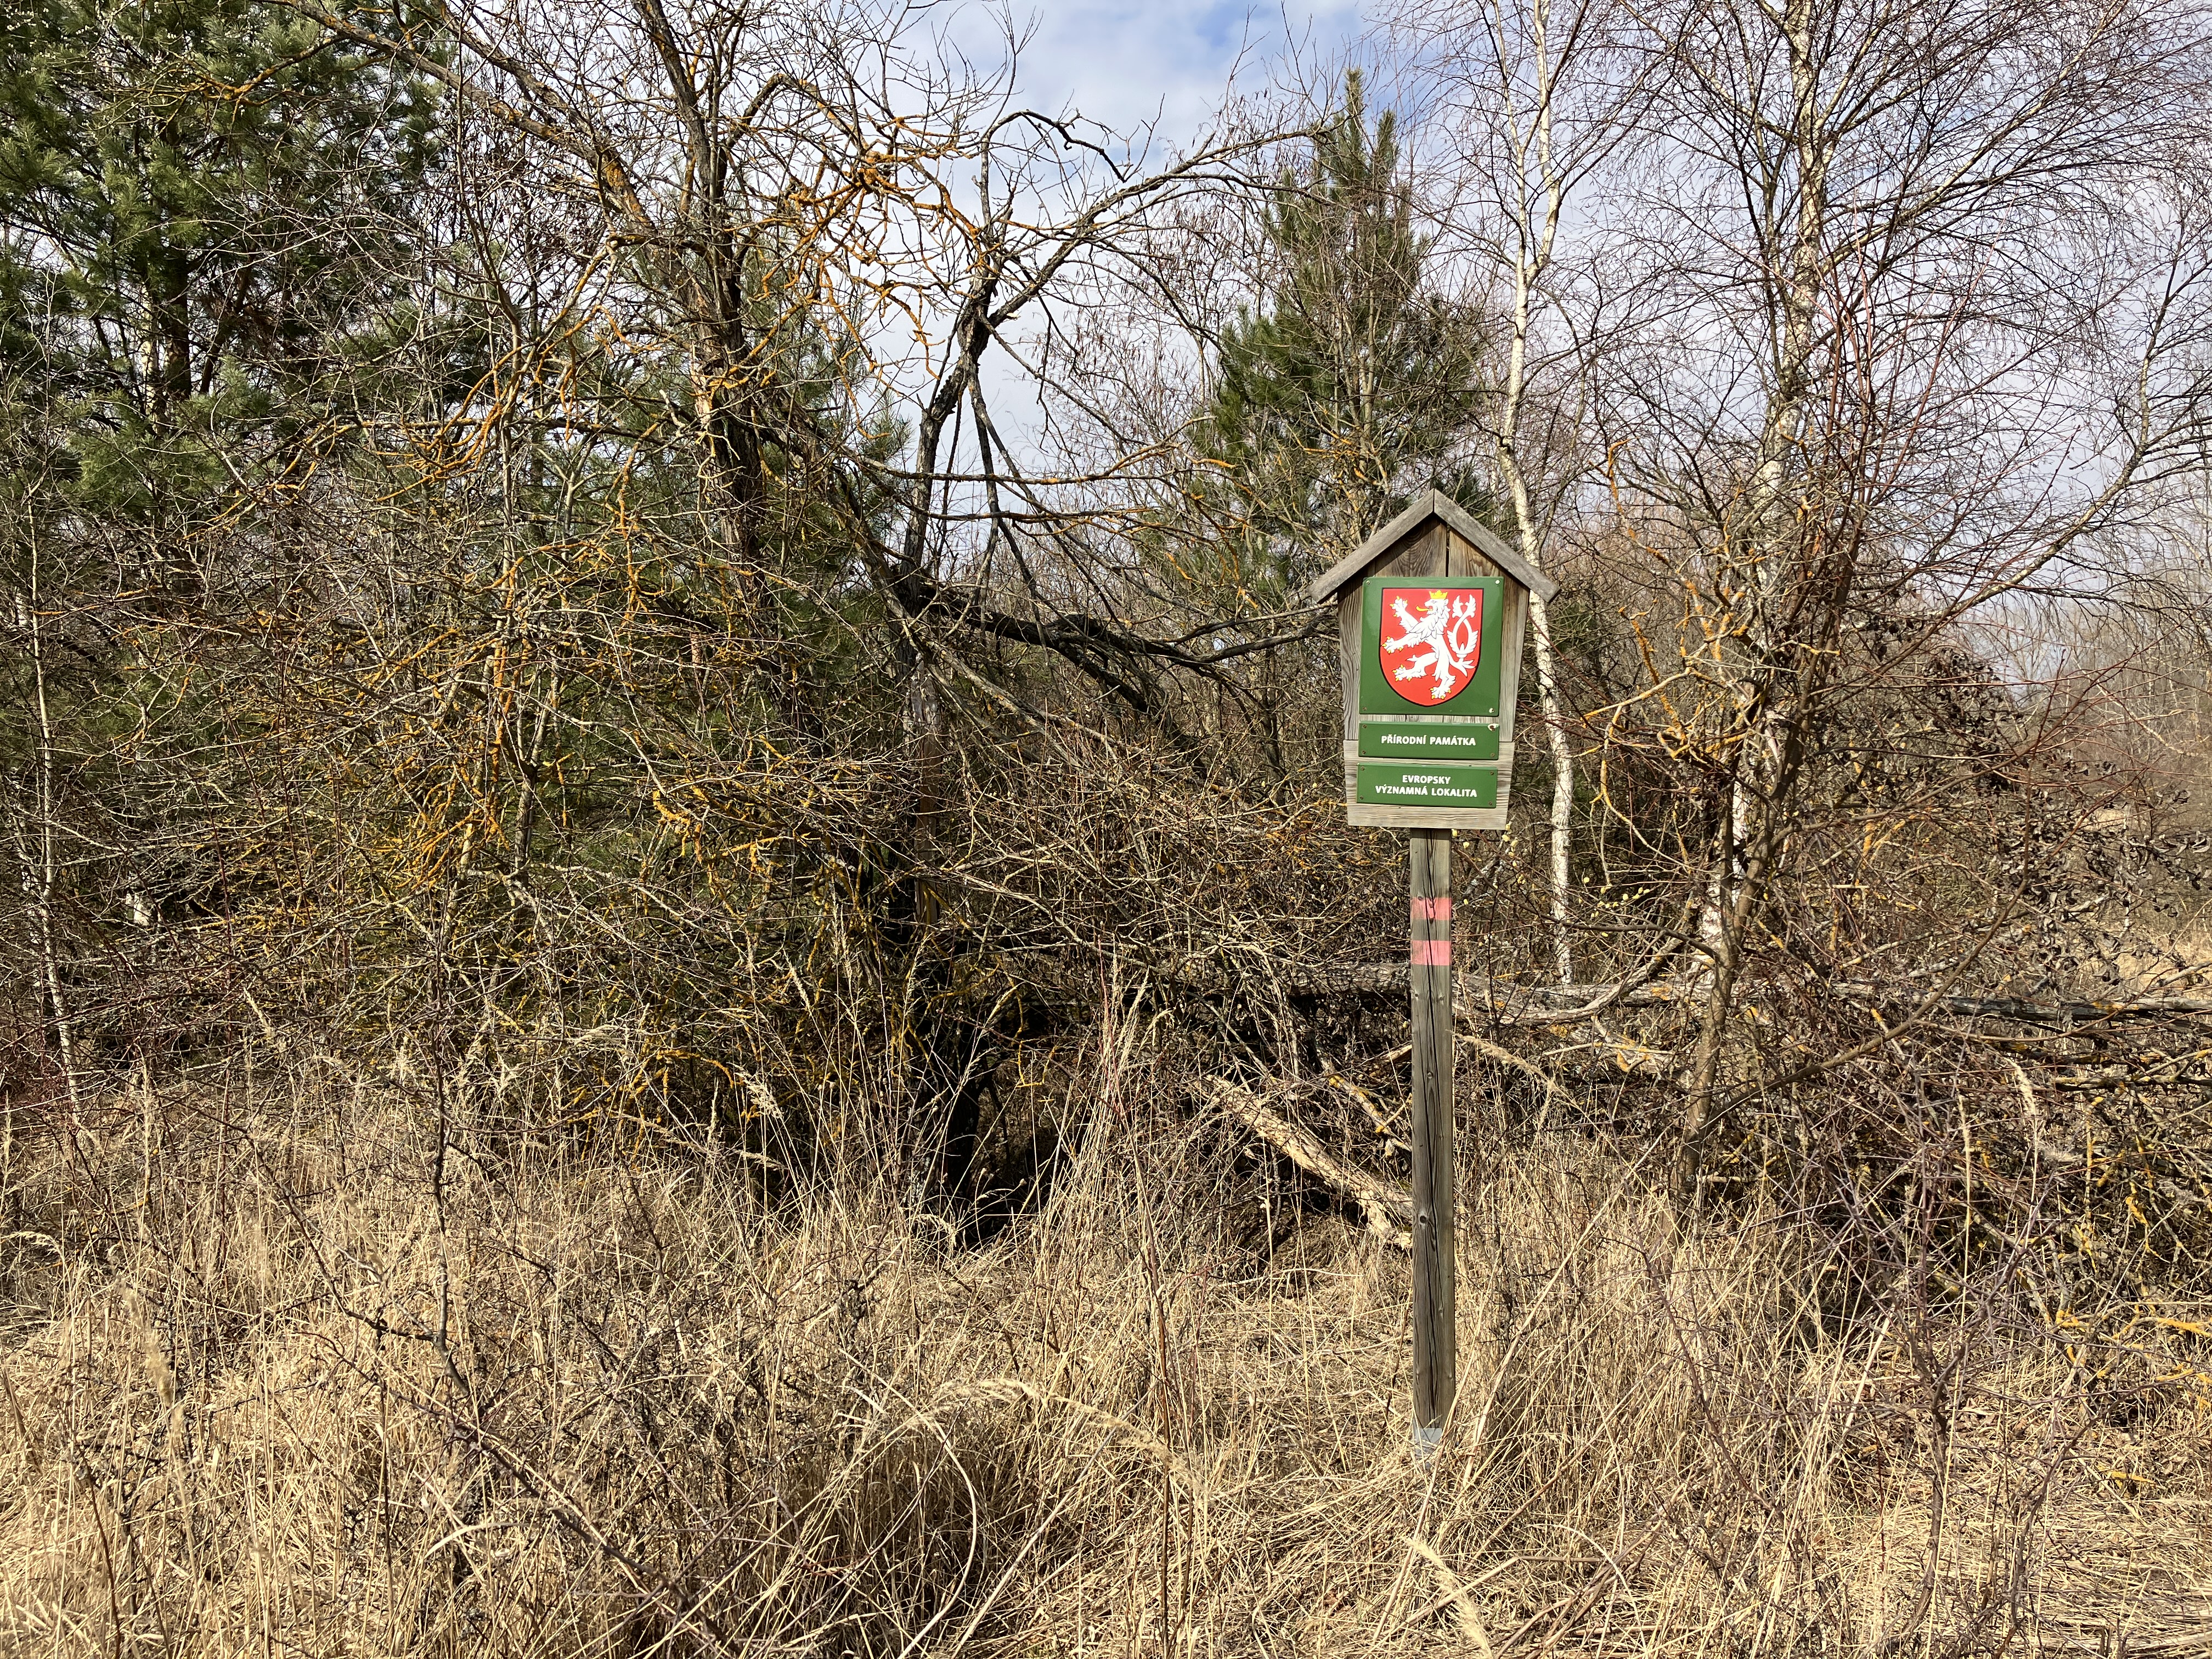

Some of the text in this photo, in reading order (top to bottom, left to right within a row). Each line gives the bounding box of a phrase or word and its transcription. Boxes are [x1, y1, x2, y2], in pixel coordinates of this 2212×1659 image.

[1381, 734, 1476, 746] PŘÍRODNÍ PAMÁTKA
[1402, 775, 1451, 785] EVROPSKY
[1375, 783, 1477, 797] VÝZNAMNÁ LOKALITA
